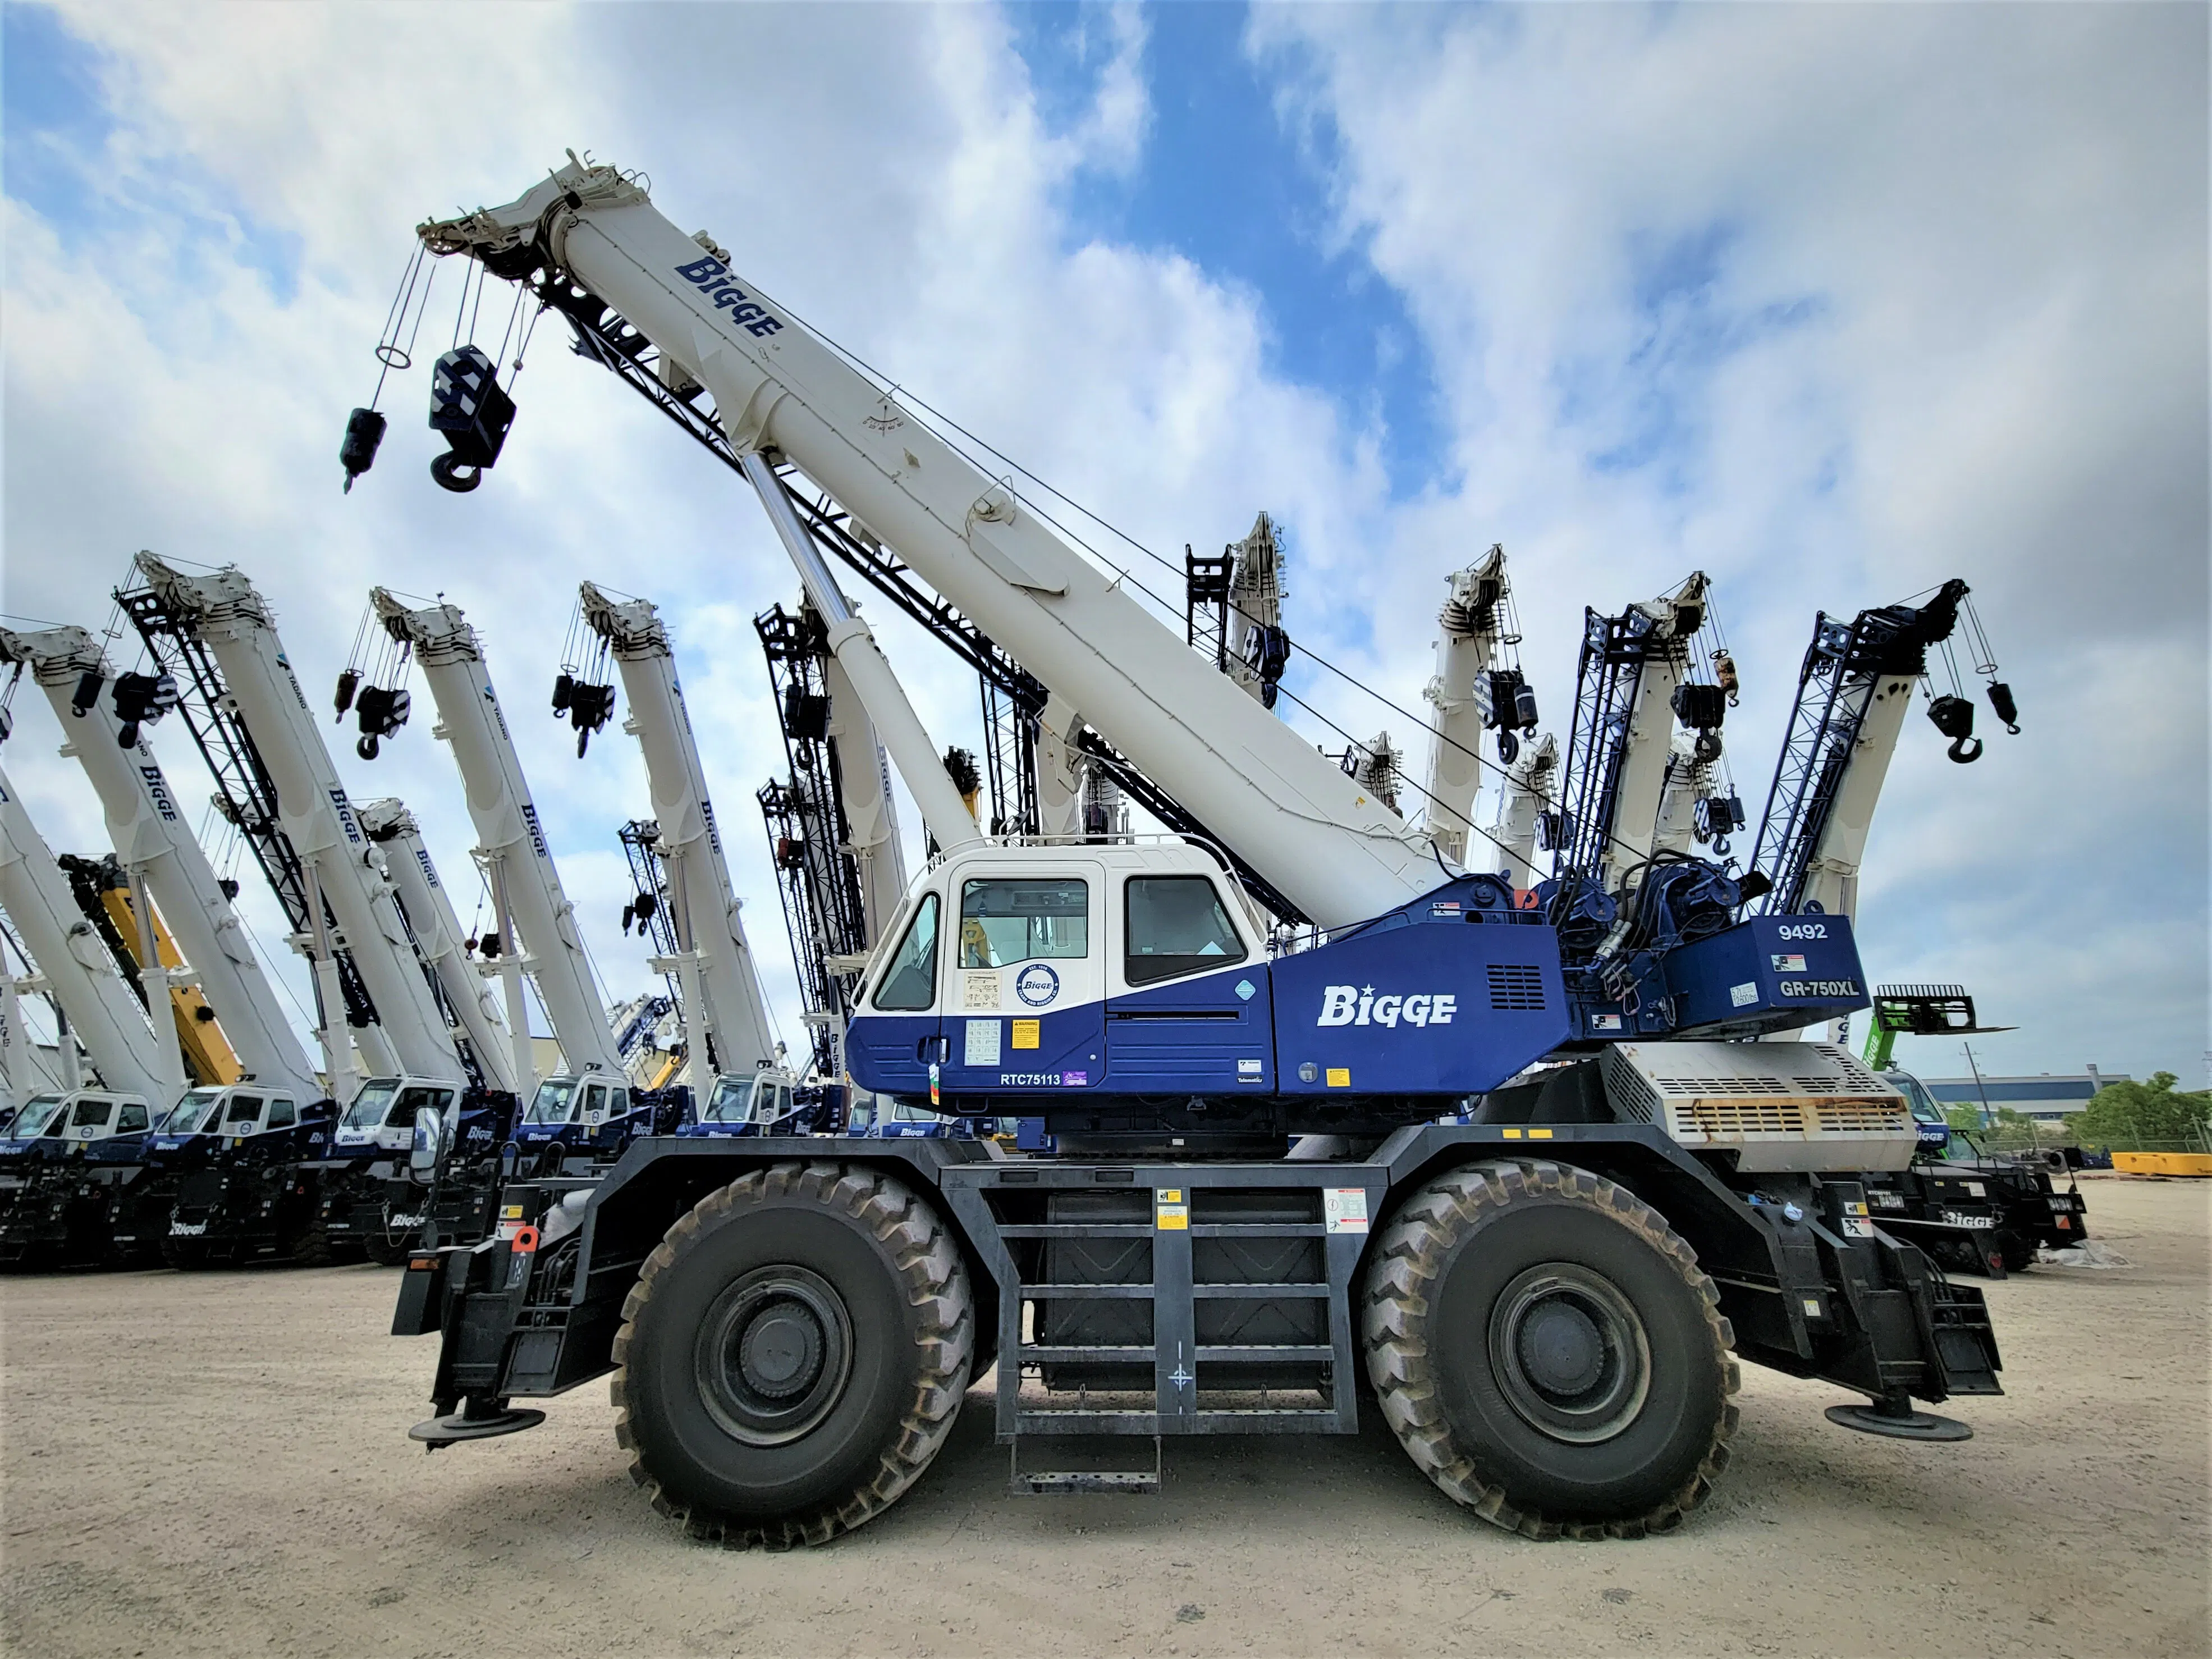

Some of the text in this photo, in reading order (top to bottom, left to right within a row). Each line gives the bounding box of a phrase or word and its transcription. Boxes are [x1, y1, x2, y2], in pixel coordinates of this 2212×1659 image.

[288, 675, 306, 710] TADANO
[493, 707, 508, 741] TADANO
[1778, 924, 1828, 940] 9492
[1780, 981, 1860, 997] GR-750XL
[1000, 1074, 1060, 1085] RTC75113
